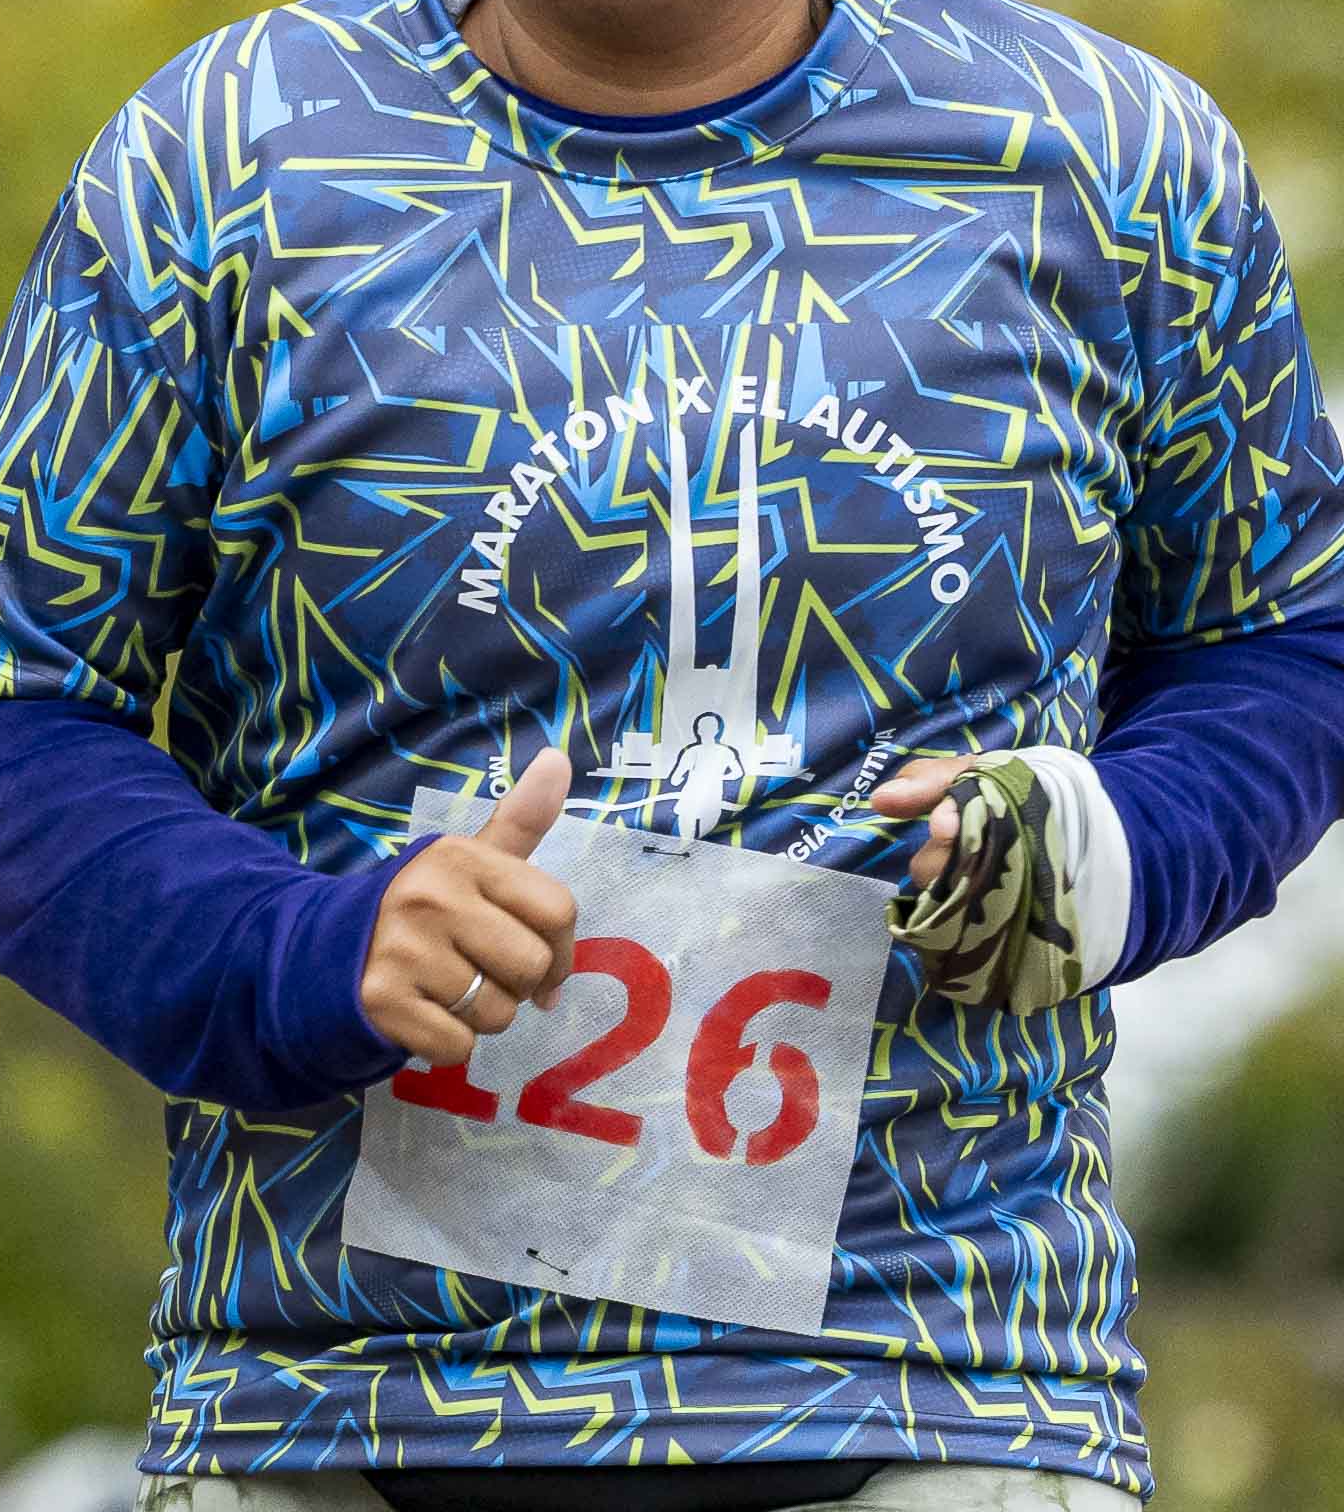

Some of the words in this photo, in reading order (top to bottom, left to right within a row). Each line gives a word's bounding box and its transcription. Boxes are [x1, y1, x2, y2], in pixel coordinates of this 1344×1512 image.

[457, 387, 654, 614] MARATÓN
[672, 376, 712, 416] X
[732, 375, 787, 421] EL
[799, 394, 971, 604] AUTISMO
